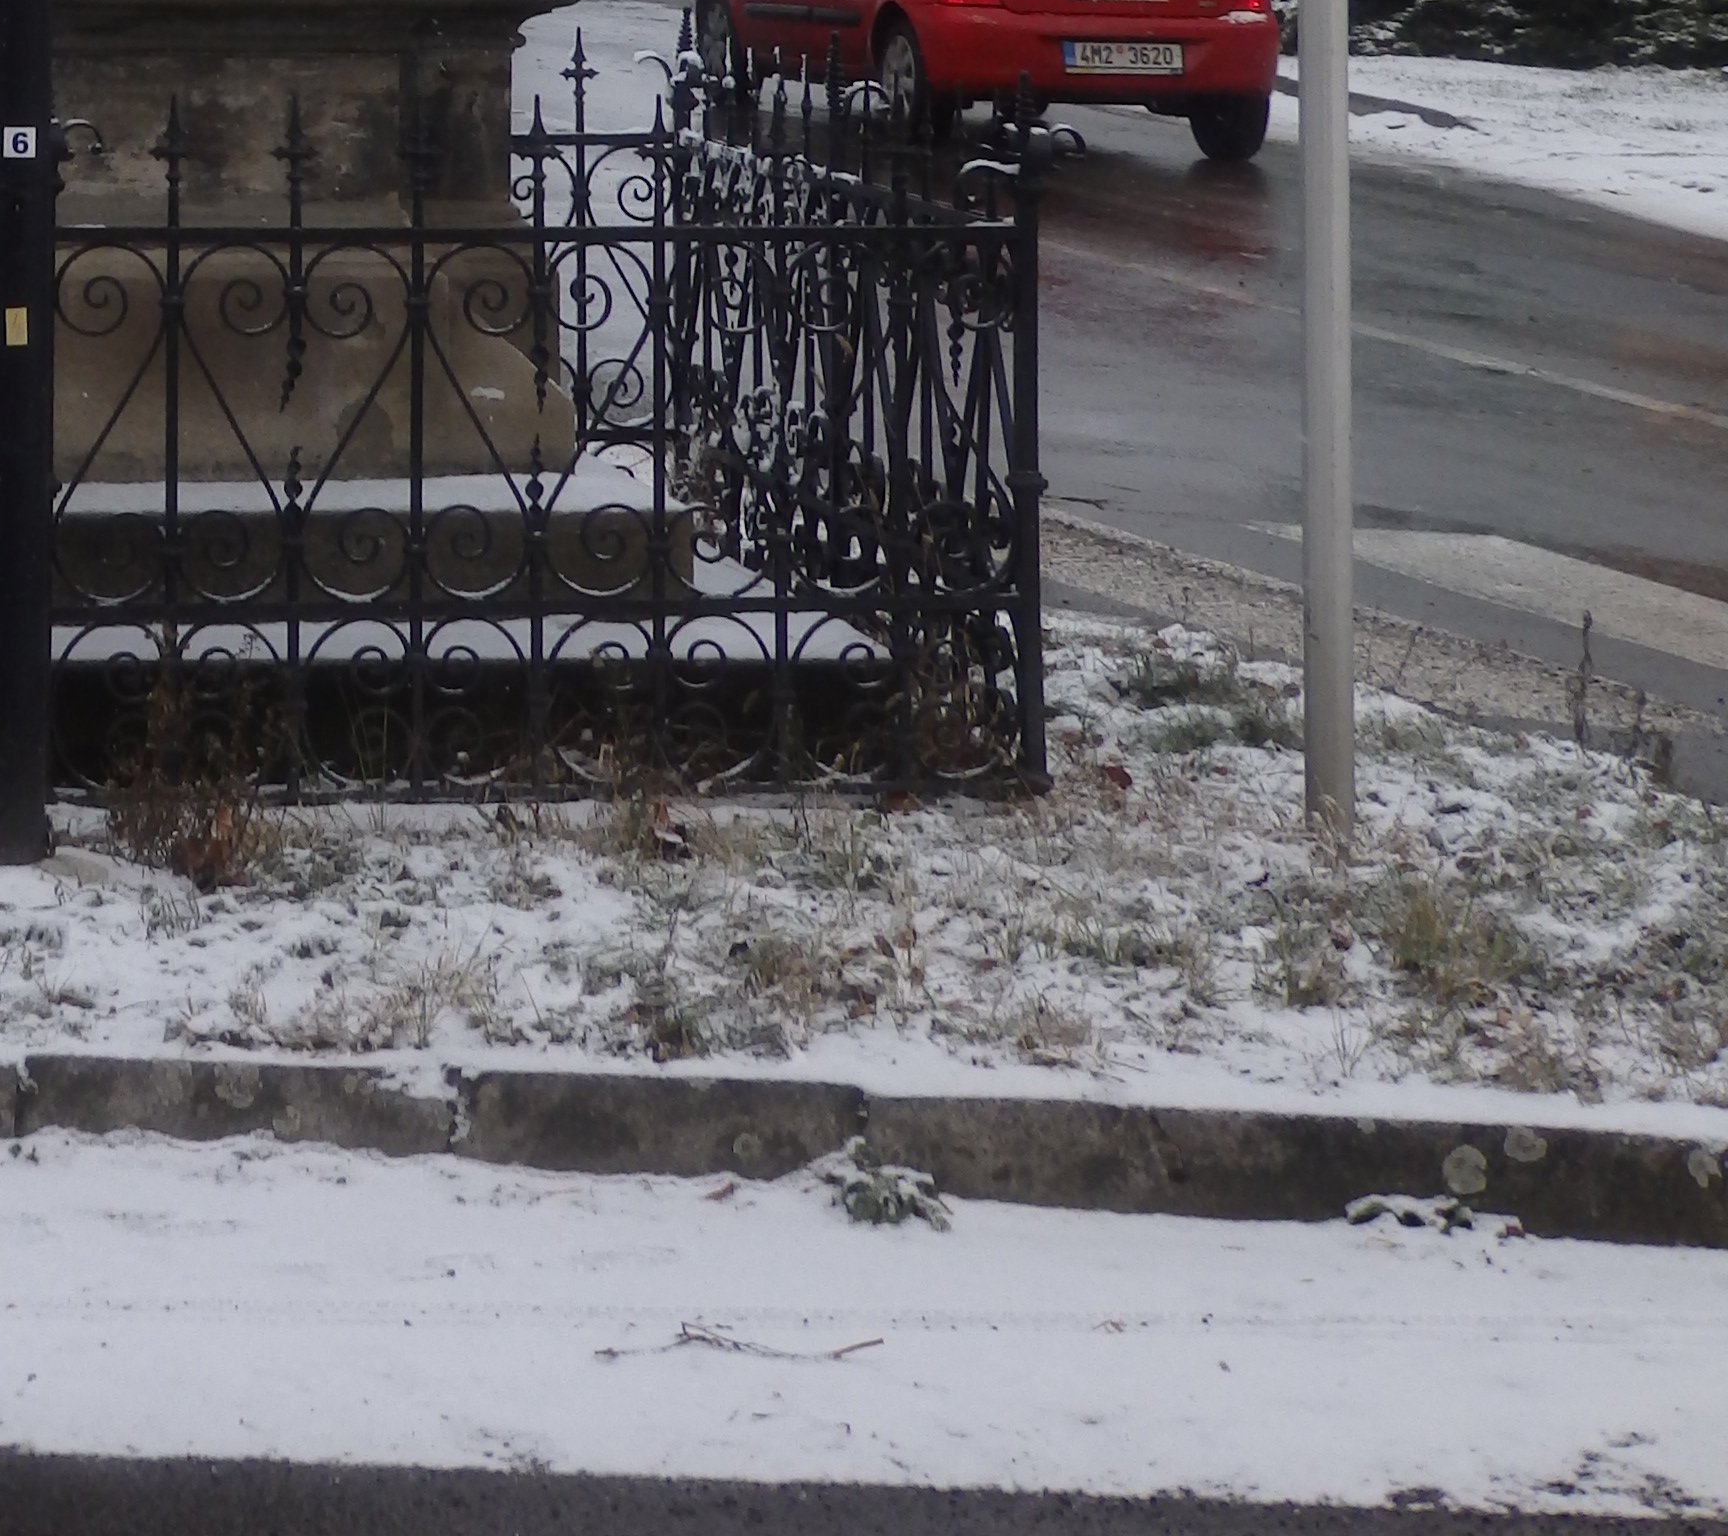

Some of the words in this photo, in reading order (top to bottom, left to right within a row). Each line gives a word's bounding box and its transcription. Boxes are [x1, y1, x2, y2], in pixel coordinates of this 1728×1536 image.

[1080, 44, 1113, 65] 4M2
[1128, 46, 1173, 66] 3620
[12, 132, 29, 154] 6
